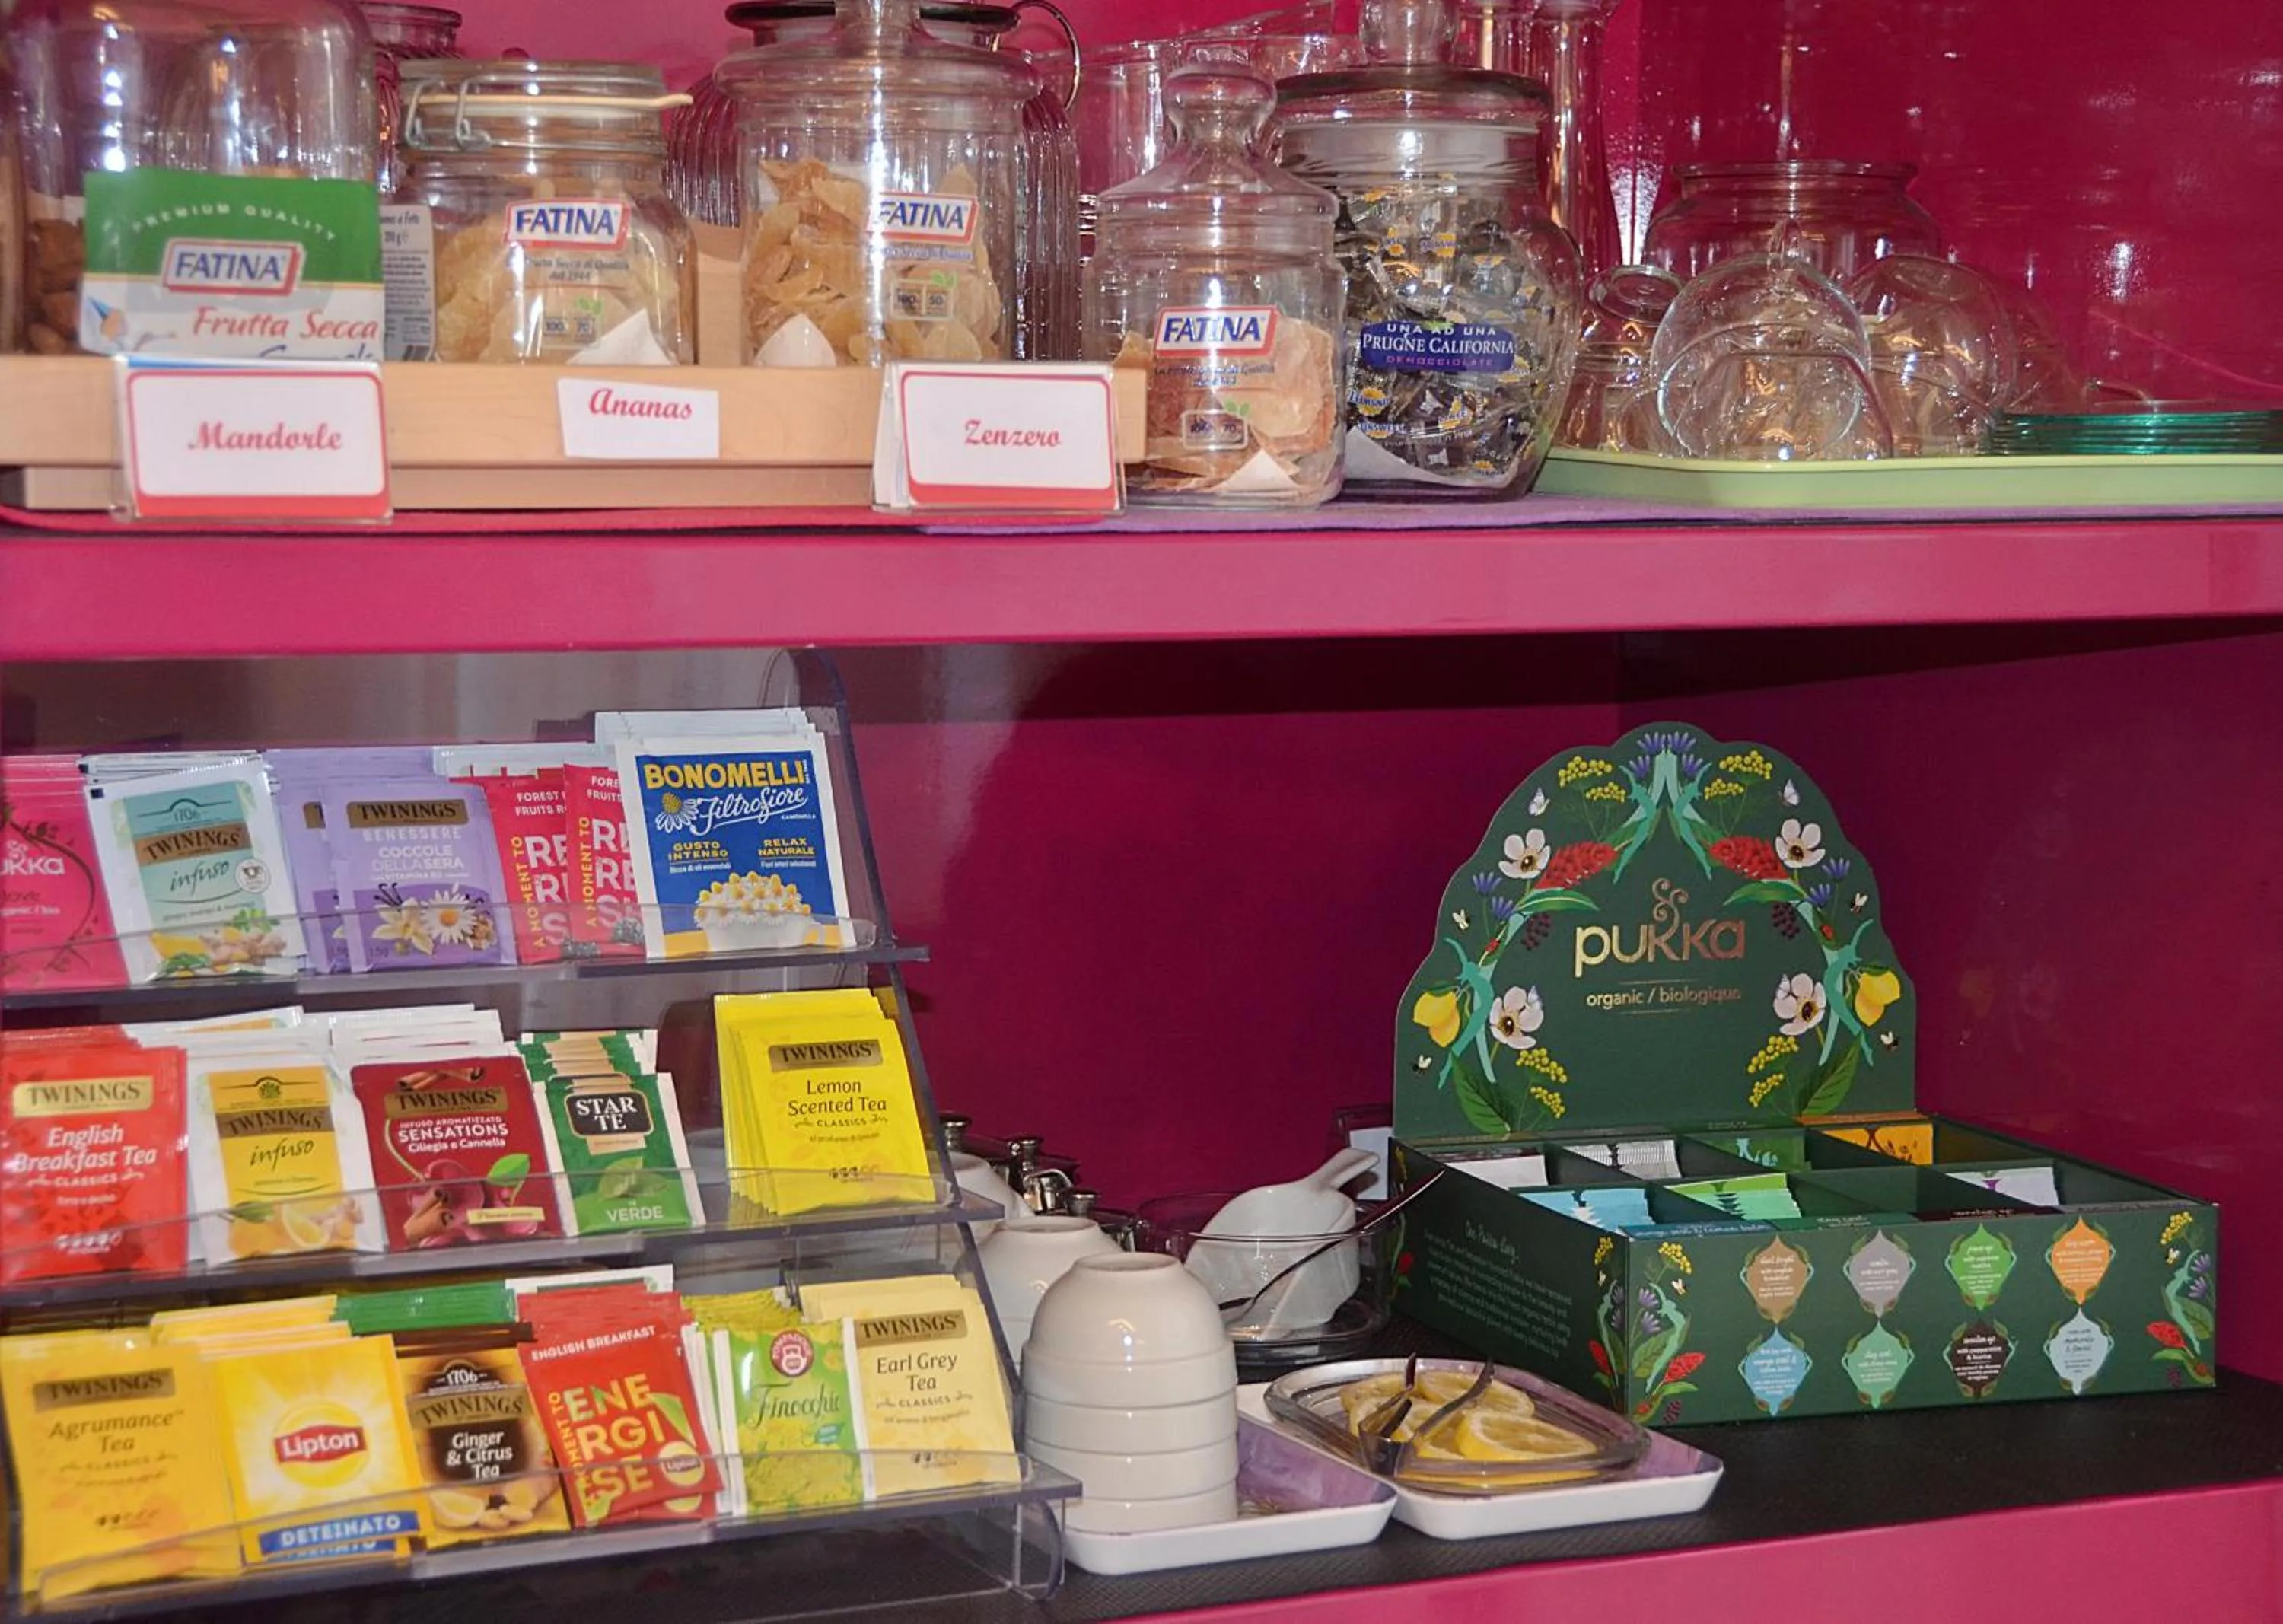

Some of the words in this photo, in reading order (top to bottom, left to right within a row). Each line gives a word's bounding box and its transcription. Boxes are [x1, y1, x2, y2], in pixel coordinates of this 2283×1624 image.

[132, 203, 230, 232] PREMIUM
[244, 205, 336, 241] QUALITY
[515, 207, 615, 236] FATINA
[175, 251, 281, 282] FATINA
[193, 306, 290, 336] Frutta
[299, 308, 379, 340] Secca
[1164, 316, 1261, 342] FATINA
[1387, 323, 1423, 335] UNA
[1463, 326, 1496, 336] UNA
[1362, 333, 1425, 353] PRUGNE
[1429, 337, 1514, 355] CALIFORNIA
[1386, 355, 1493, 367] DENOCCIOLATE
[588, 388, 693, 420] Ananas
[188, 422, 343, 452] Mandorle
[963, 419, 1062, 447] Zenzero
[591, 775, 619, 787] FORE
[644, 759, 804, 790] BONOMELLI
[517, 791, 559, 803] FOREST
[358, 802, 456, 820] TWININGS
[515, 805, 554, 816] FRUITS
[690, 787, 809, 836] Filtrofiore
[363, 827, 463, 842] BENESSERE
[578, 816, 591, 836] TO
[145, 829, 241, 861] TWININGS
[379, 845, 453, 858] COCCOLE
[511, 836, 525, 858] TO
[673, 841, 721, 852] GUSTO
[758, 846, 815, 857] NATURALE
[763, 838, 807, 848] RELAX
[668, 849, 728, 861] INTENSO
[170, 860, 230, 898] infuso
[579, 842, 597, 911] MOMENT
[515, 862, 543, 933] MOMENT
[1575, 909, 1746, 979] pukka
[1587, 989, 1645, 1011] organic
[1648, 986, 1656, 1004] /
[1660, 985, 1741, 1008] biologique
[780, 1043, 872, 1062] TWININGS
[27, 1081, 141, 1107] TWININGS
[807, 1079, 861, 1096] Lemon
[396, 1088, 497, 1111] TWININGS
[576, 1097, 638, 1116] STAR
[788, 1097, 853, 1116] Scented
[858, 1096, 887, 1112] Tea
[228, 1110, 323, 1135] TWININGS
[398, 1122, 509, 1142] SENSATIONS
[400, 1119, 433, 1129] INFUSO
[435, 1116, 503, 1126] AROMATIZZATO
[817, 1117, 867, 1128] CLASSICS
[47, 1122, 124, 1151] English
[409, 1141, 448, 1153] Ciliegia
[450, 1142, 457, 1150] e
[459, 1138, 506, 1149] Cannella
[13, 1150, 117, 1174] Breakfast
[122, 1145, 158, 1167] Tea
[250, 1137, 314, 1173] infuso
[606, 1206, 664, 1222] VERDE
[861, 1315, 957, 1339] TWININGS
[531, 1340, 585, 1361] ENGLISH
[587, 1325, 656, 1350] BREAKFAST
[877, 1353, 912, 1374] Earl
[917, 1352, 957, 1372] Grey
[47, 1374, 162, 1400] TWININGS
[447, 1369, 478, 1385] 1706
[906, 1374, 936, 1392] Tea
[419, 1395, 524, 1425] TWININGS
[548, 1391, 562, 1415] TO
[899, 1395, 950, 1408] CLASSICS
[48, 1412, 174, 1441] Agrumance
[575, 1409, 665, 1462] RGI
[99, 1434, 135, 1454] Tea
[281, 1431, 360, 1459] Lipton
[452, 1431, 505, 1450] Ginger
[446, 1450, 462, 1467] &
[465, 1447, 513, 1463] Citrus
[471, 1463, 501, 1479] Tea
[281, 1513, 401, 1547] DETEINATO
